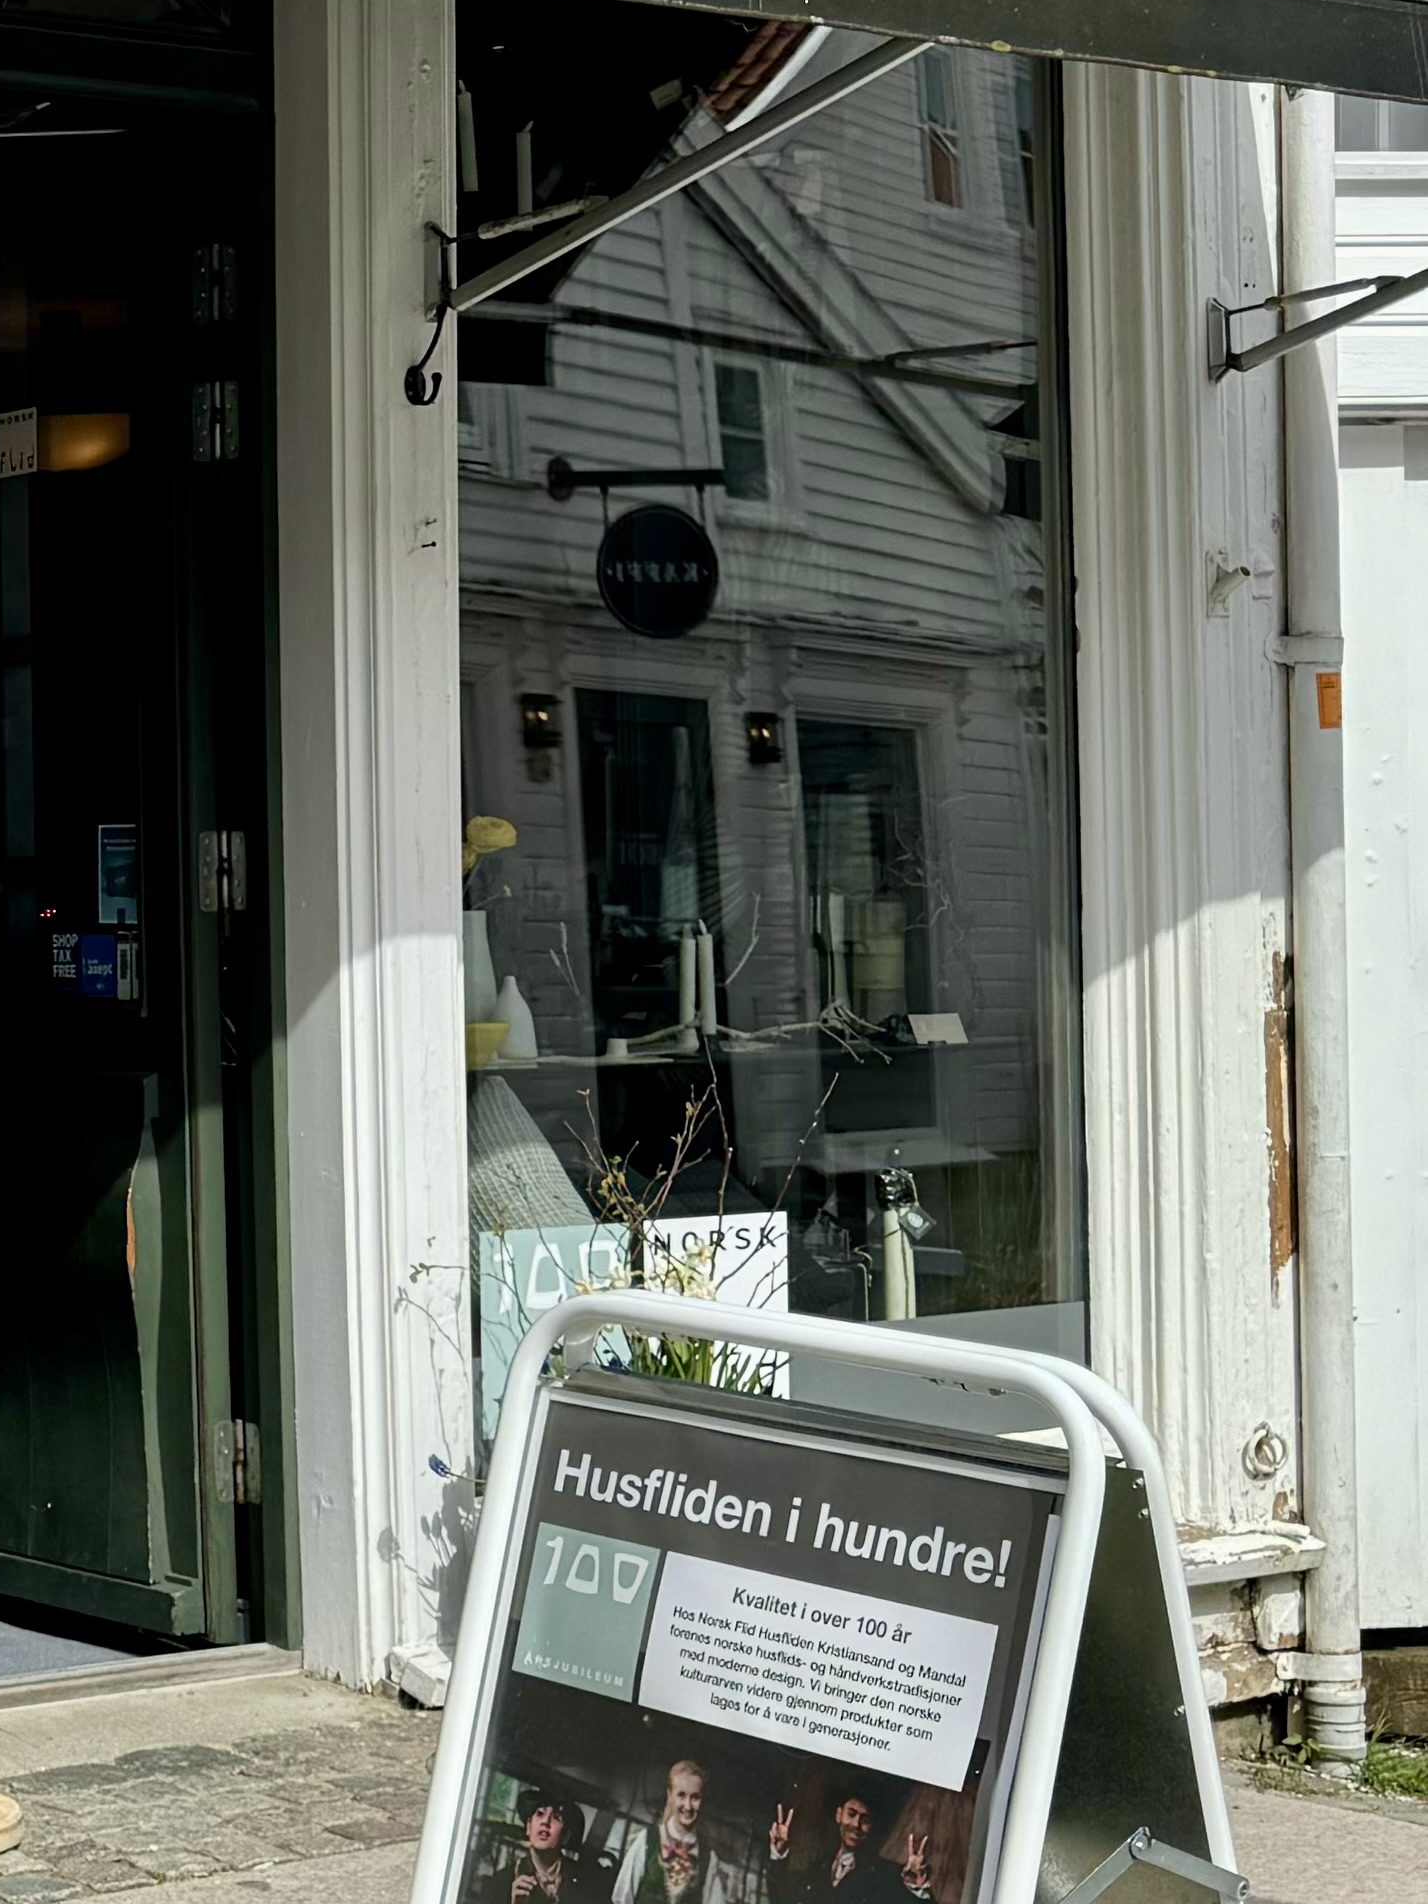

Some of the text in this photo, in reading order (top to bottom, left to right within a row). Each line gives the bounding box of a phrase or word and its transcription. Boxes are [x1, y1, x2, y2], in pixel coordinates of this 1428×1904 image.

[52, 933, 78, 948] SHOP
[52, 949, 72, 962] TAX
[53, 964, 77, 978] FREE
[653, 1225, 779, 1257] NORSK
[552, 1449, 1012, 1589] Husfliden i hundre!
[543, 1536, 649, 1604] 100
[732, 1586, 912, 1644] Kvalitet i over 100 år
[809, 1661, 826, 1676] og
[897, 1662, 915, 1678] og
